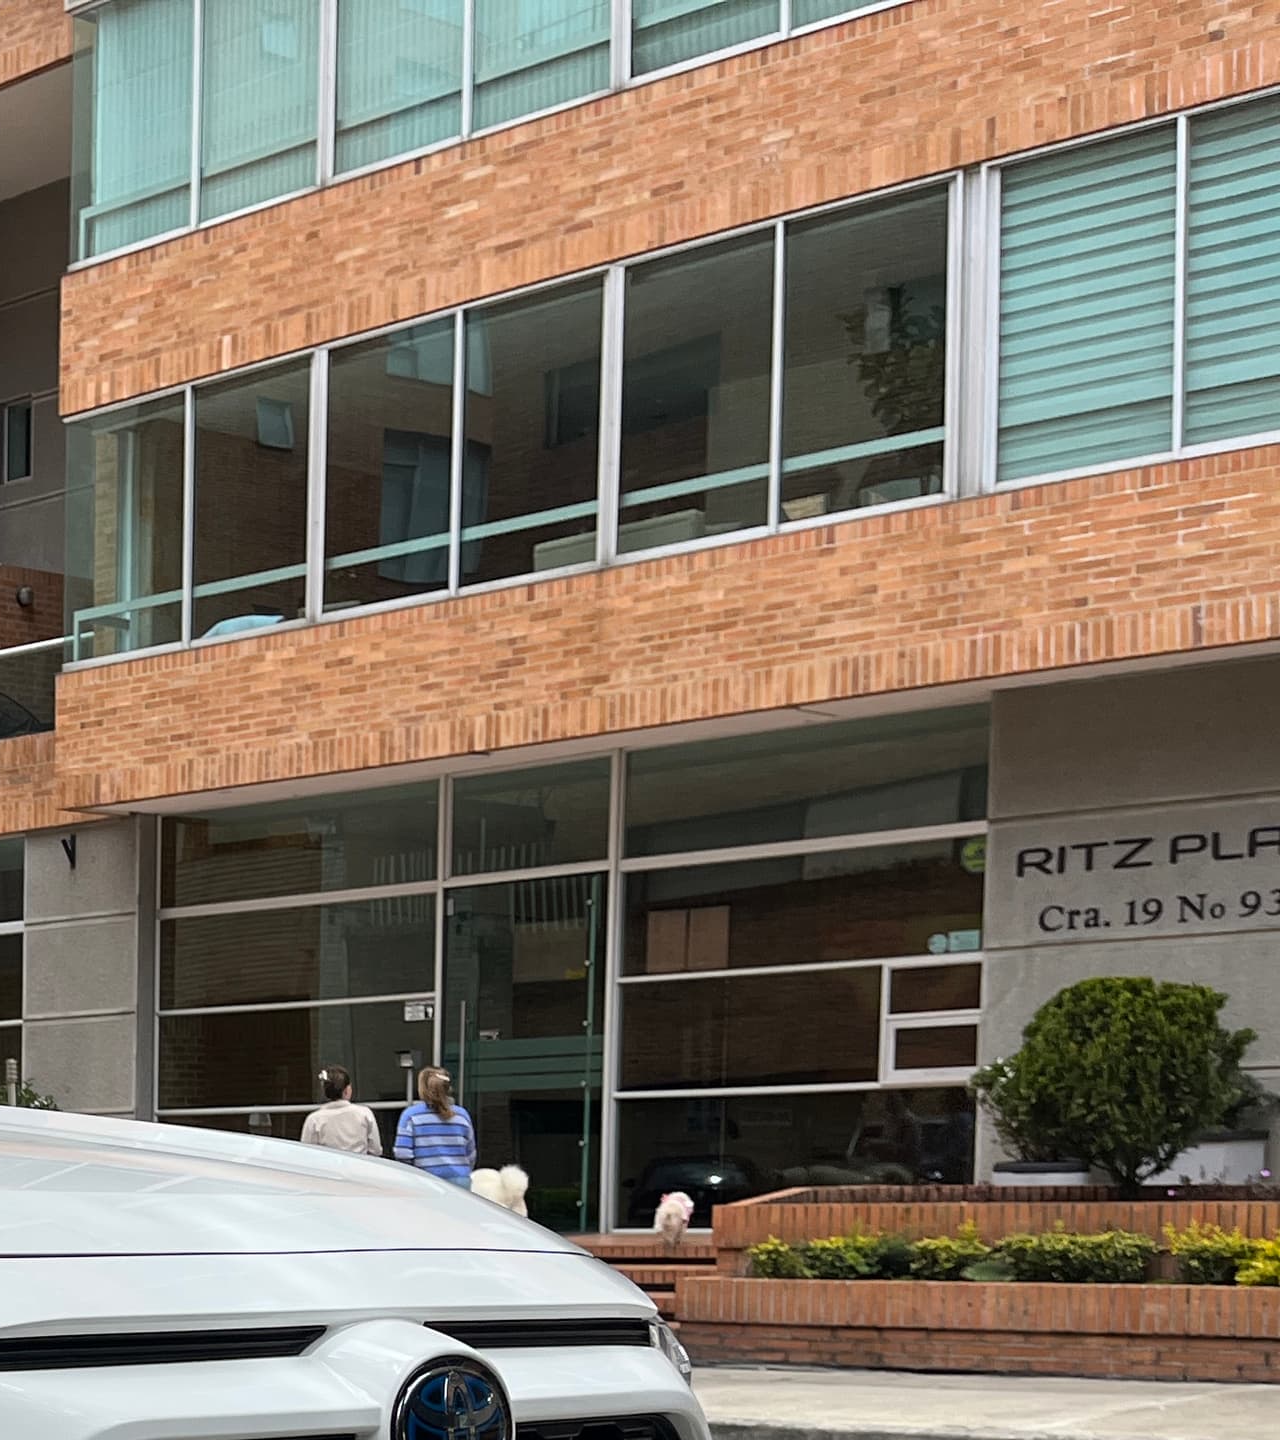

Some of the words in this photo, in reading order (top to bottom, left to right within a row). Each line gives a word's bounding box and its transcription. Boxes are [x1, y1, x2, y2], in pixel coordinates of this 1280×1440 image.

[1016, 837, 1154, 877] RITZ
[1169, 826, 1280, 865] PLA
[1039, 905, 1111, 932] Cra.
[1124, 898, 1164, 927] 19
[1176, 893, 1226, 923] No
[1239, 888, 1280, 918] 93
